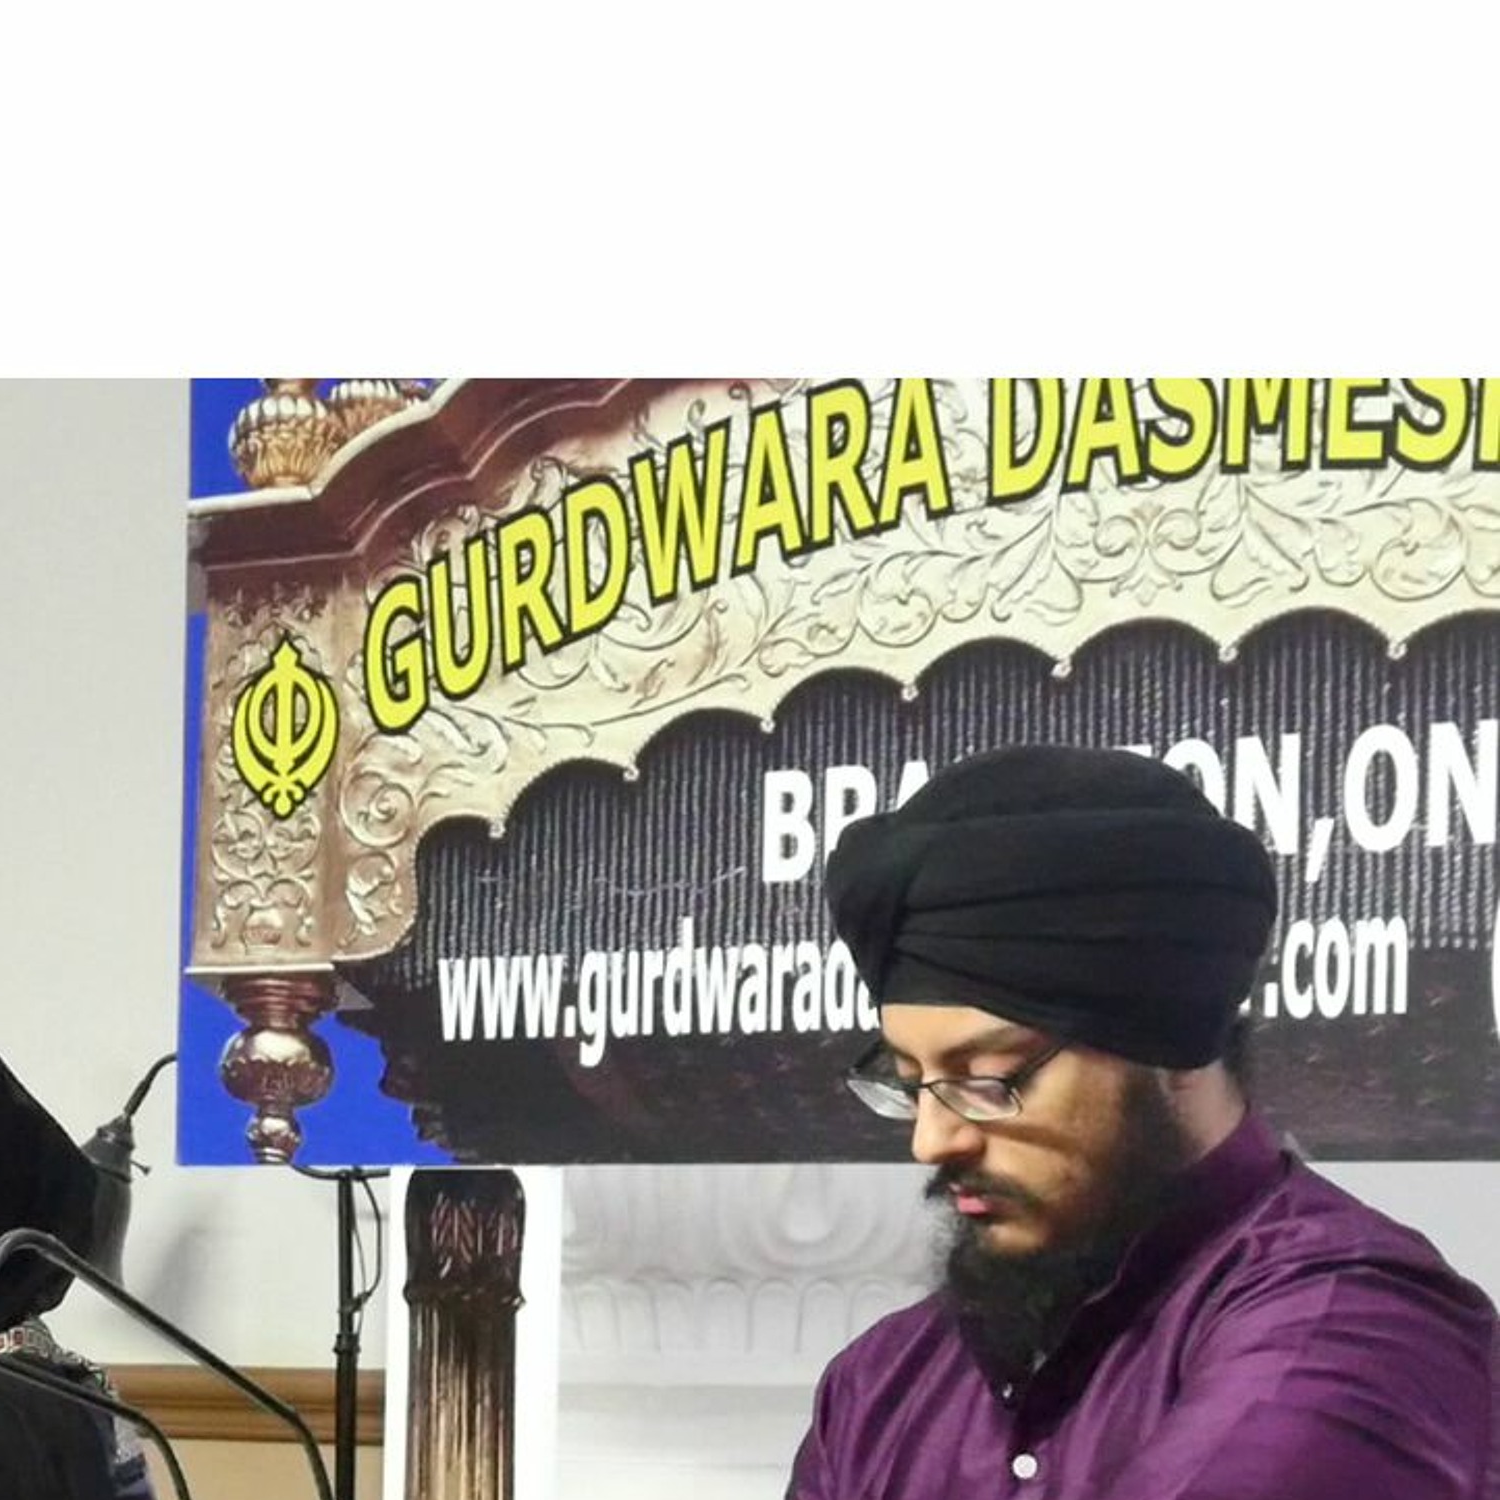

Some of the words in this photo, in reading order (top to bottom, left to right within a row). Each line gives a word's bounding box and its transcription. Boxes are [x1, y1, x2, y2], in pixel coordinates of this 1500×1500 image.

[363, 379, 953, 735] GURDWARA
[989, 379, 1500, 504] DASMES
[763, 719, 1499, 883] BRN,ON
